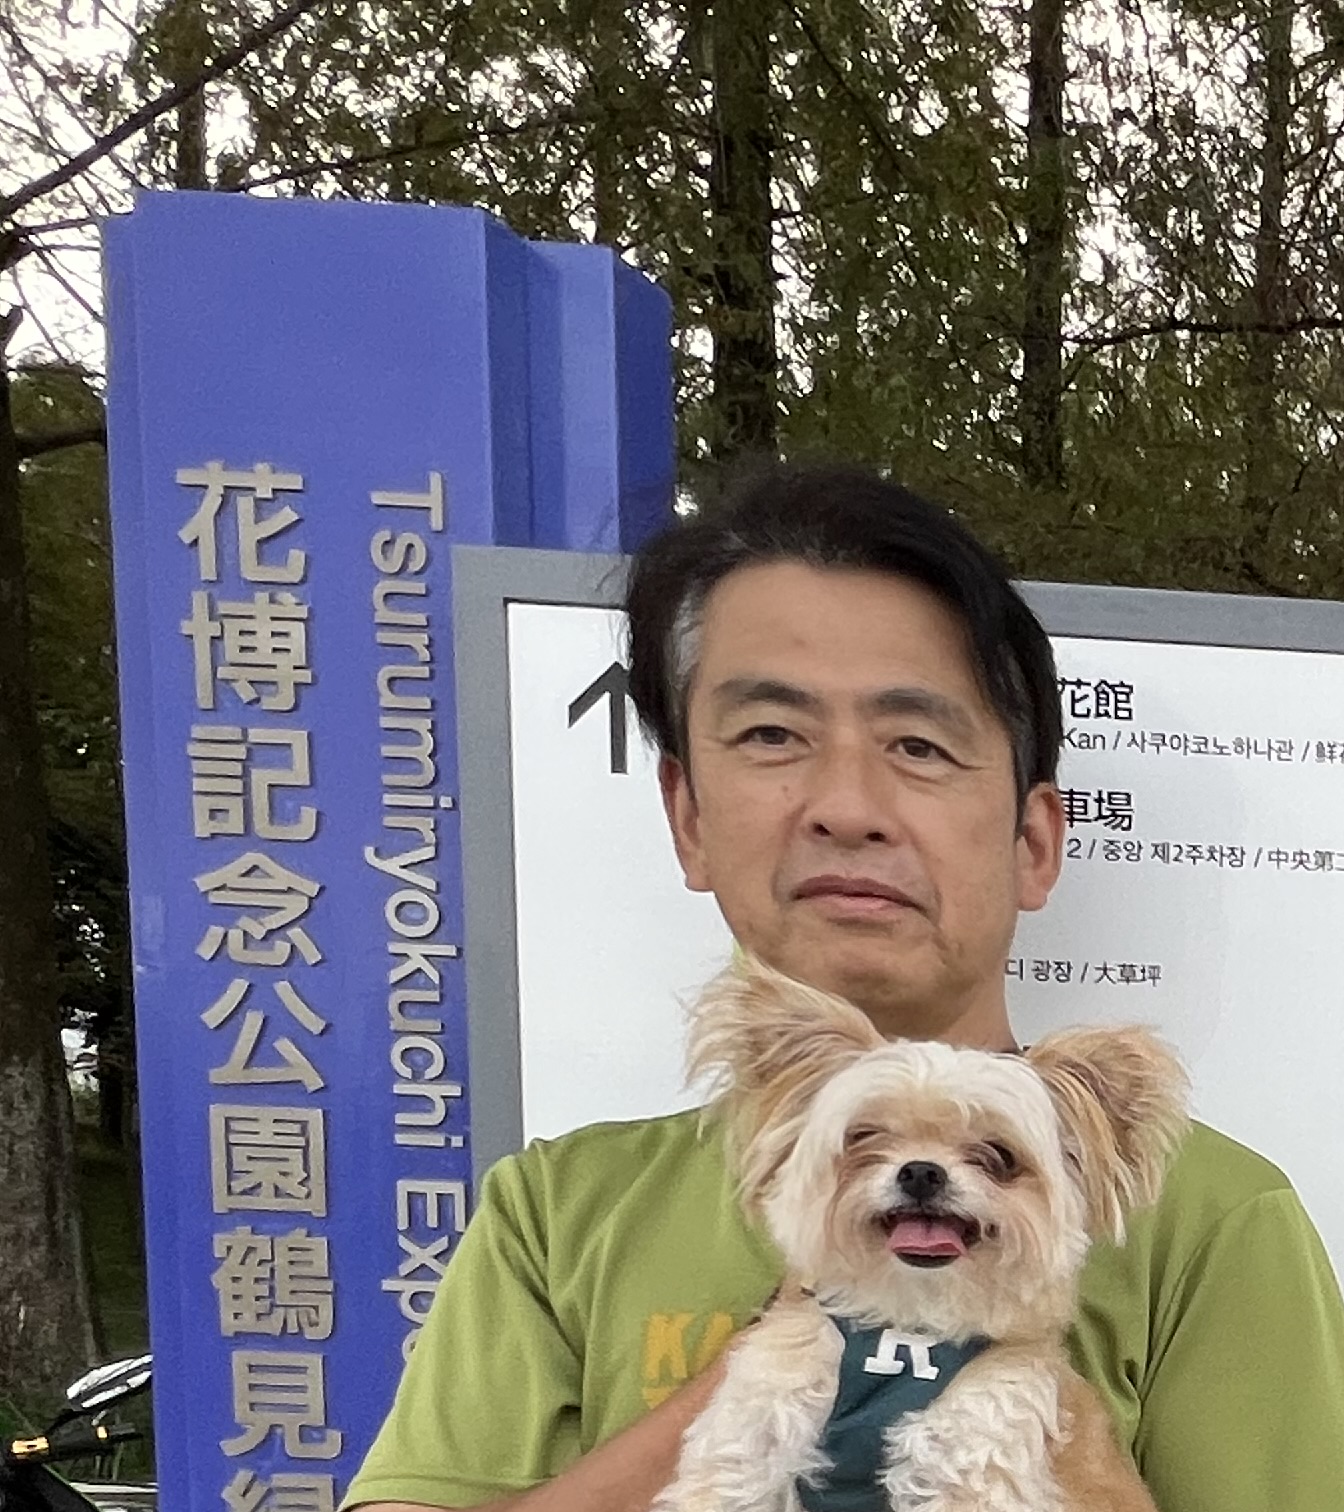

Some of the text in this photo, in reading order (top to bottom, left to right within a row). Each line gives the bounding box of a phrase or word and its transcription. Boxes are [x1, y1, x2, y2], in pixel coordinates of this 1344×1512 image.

[1126, 730, 1294, 762] 사쿠야코노하나관
[364, 471, 466, 1150] Tsurumiryokuchi
[1066, 837, 1082, 860] 2
[1102, 838, 1143, 863] 중앙
[1150, 841, 1246, 869] 제2주차장
[1031, 959, 1074, 984] 광장
[1094, 961, 1162, 987] 大草坪
